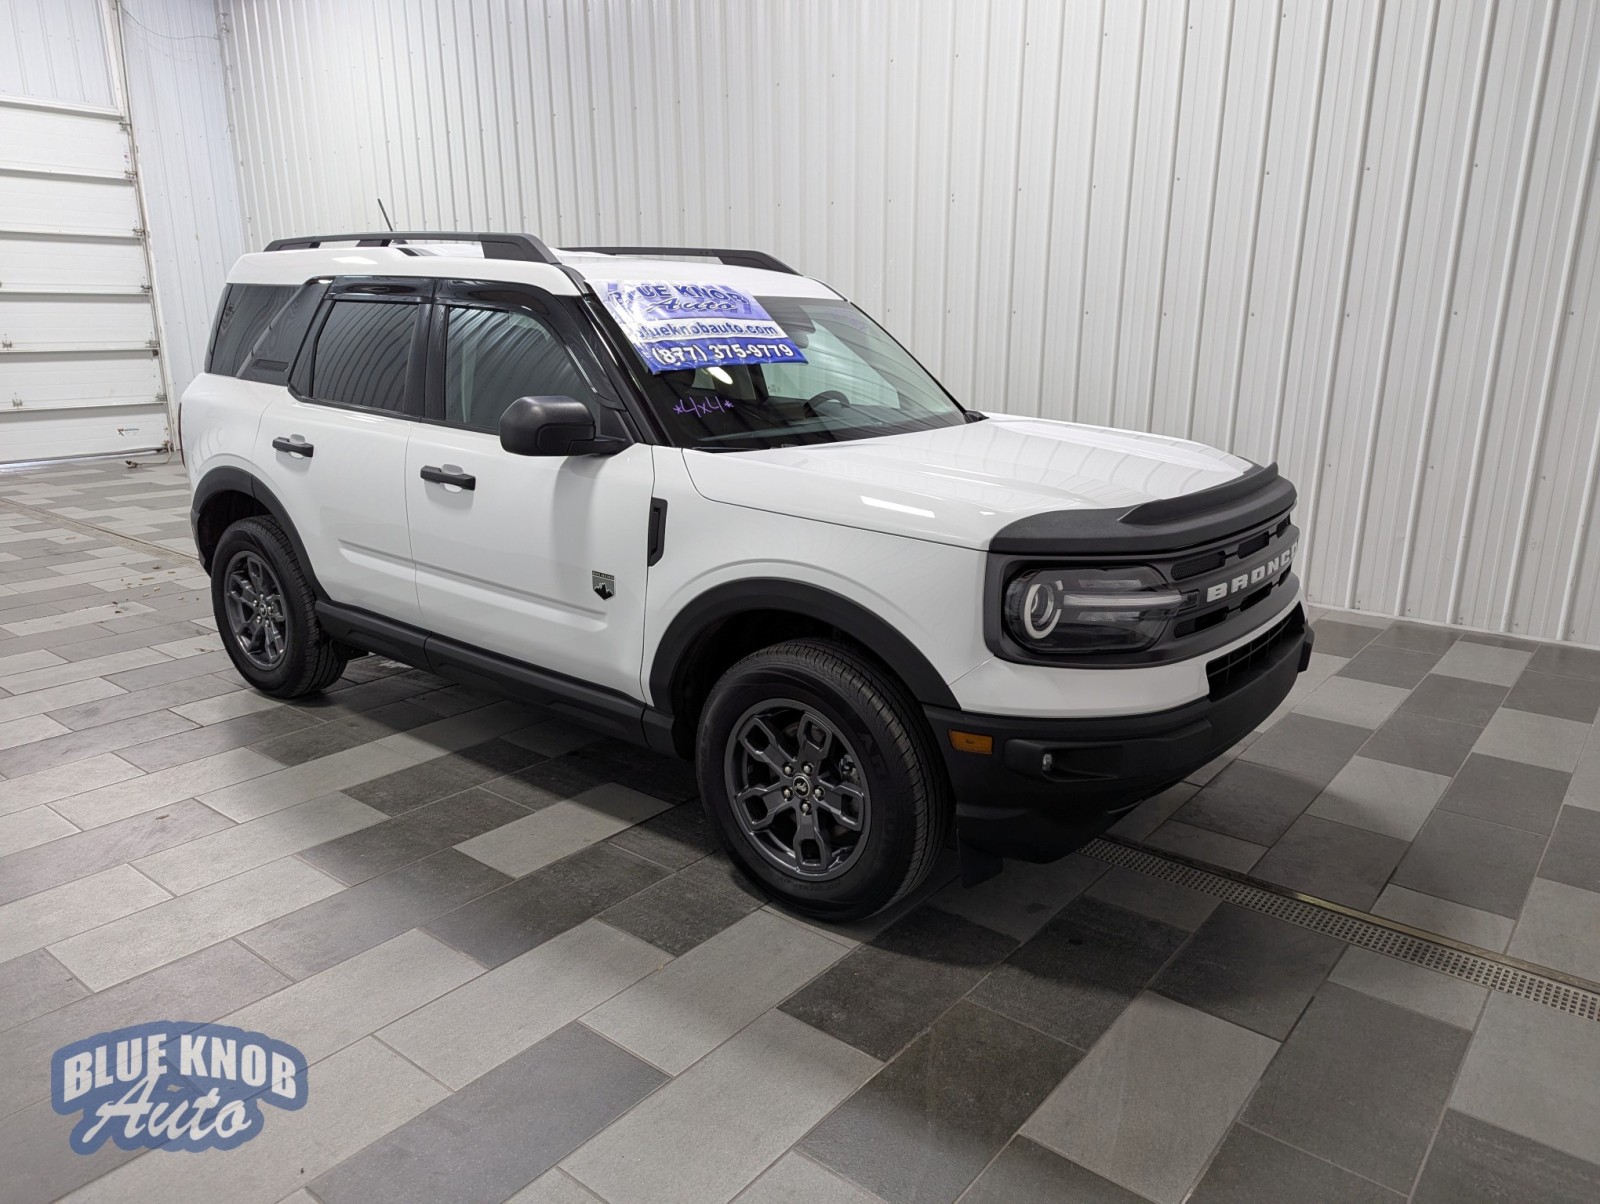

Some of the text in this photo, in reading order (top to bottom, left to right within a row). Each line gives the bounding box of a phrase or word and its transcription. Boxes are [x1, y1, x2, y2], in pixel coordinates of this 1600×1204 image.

[645, 298, 736, 313] Auto
[651, 343, 794, 365] (877) 375-9779
